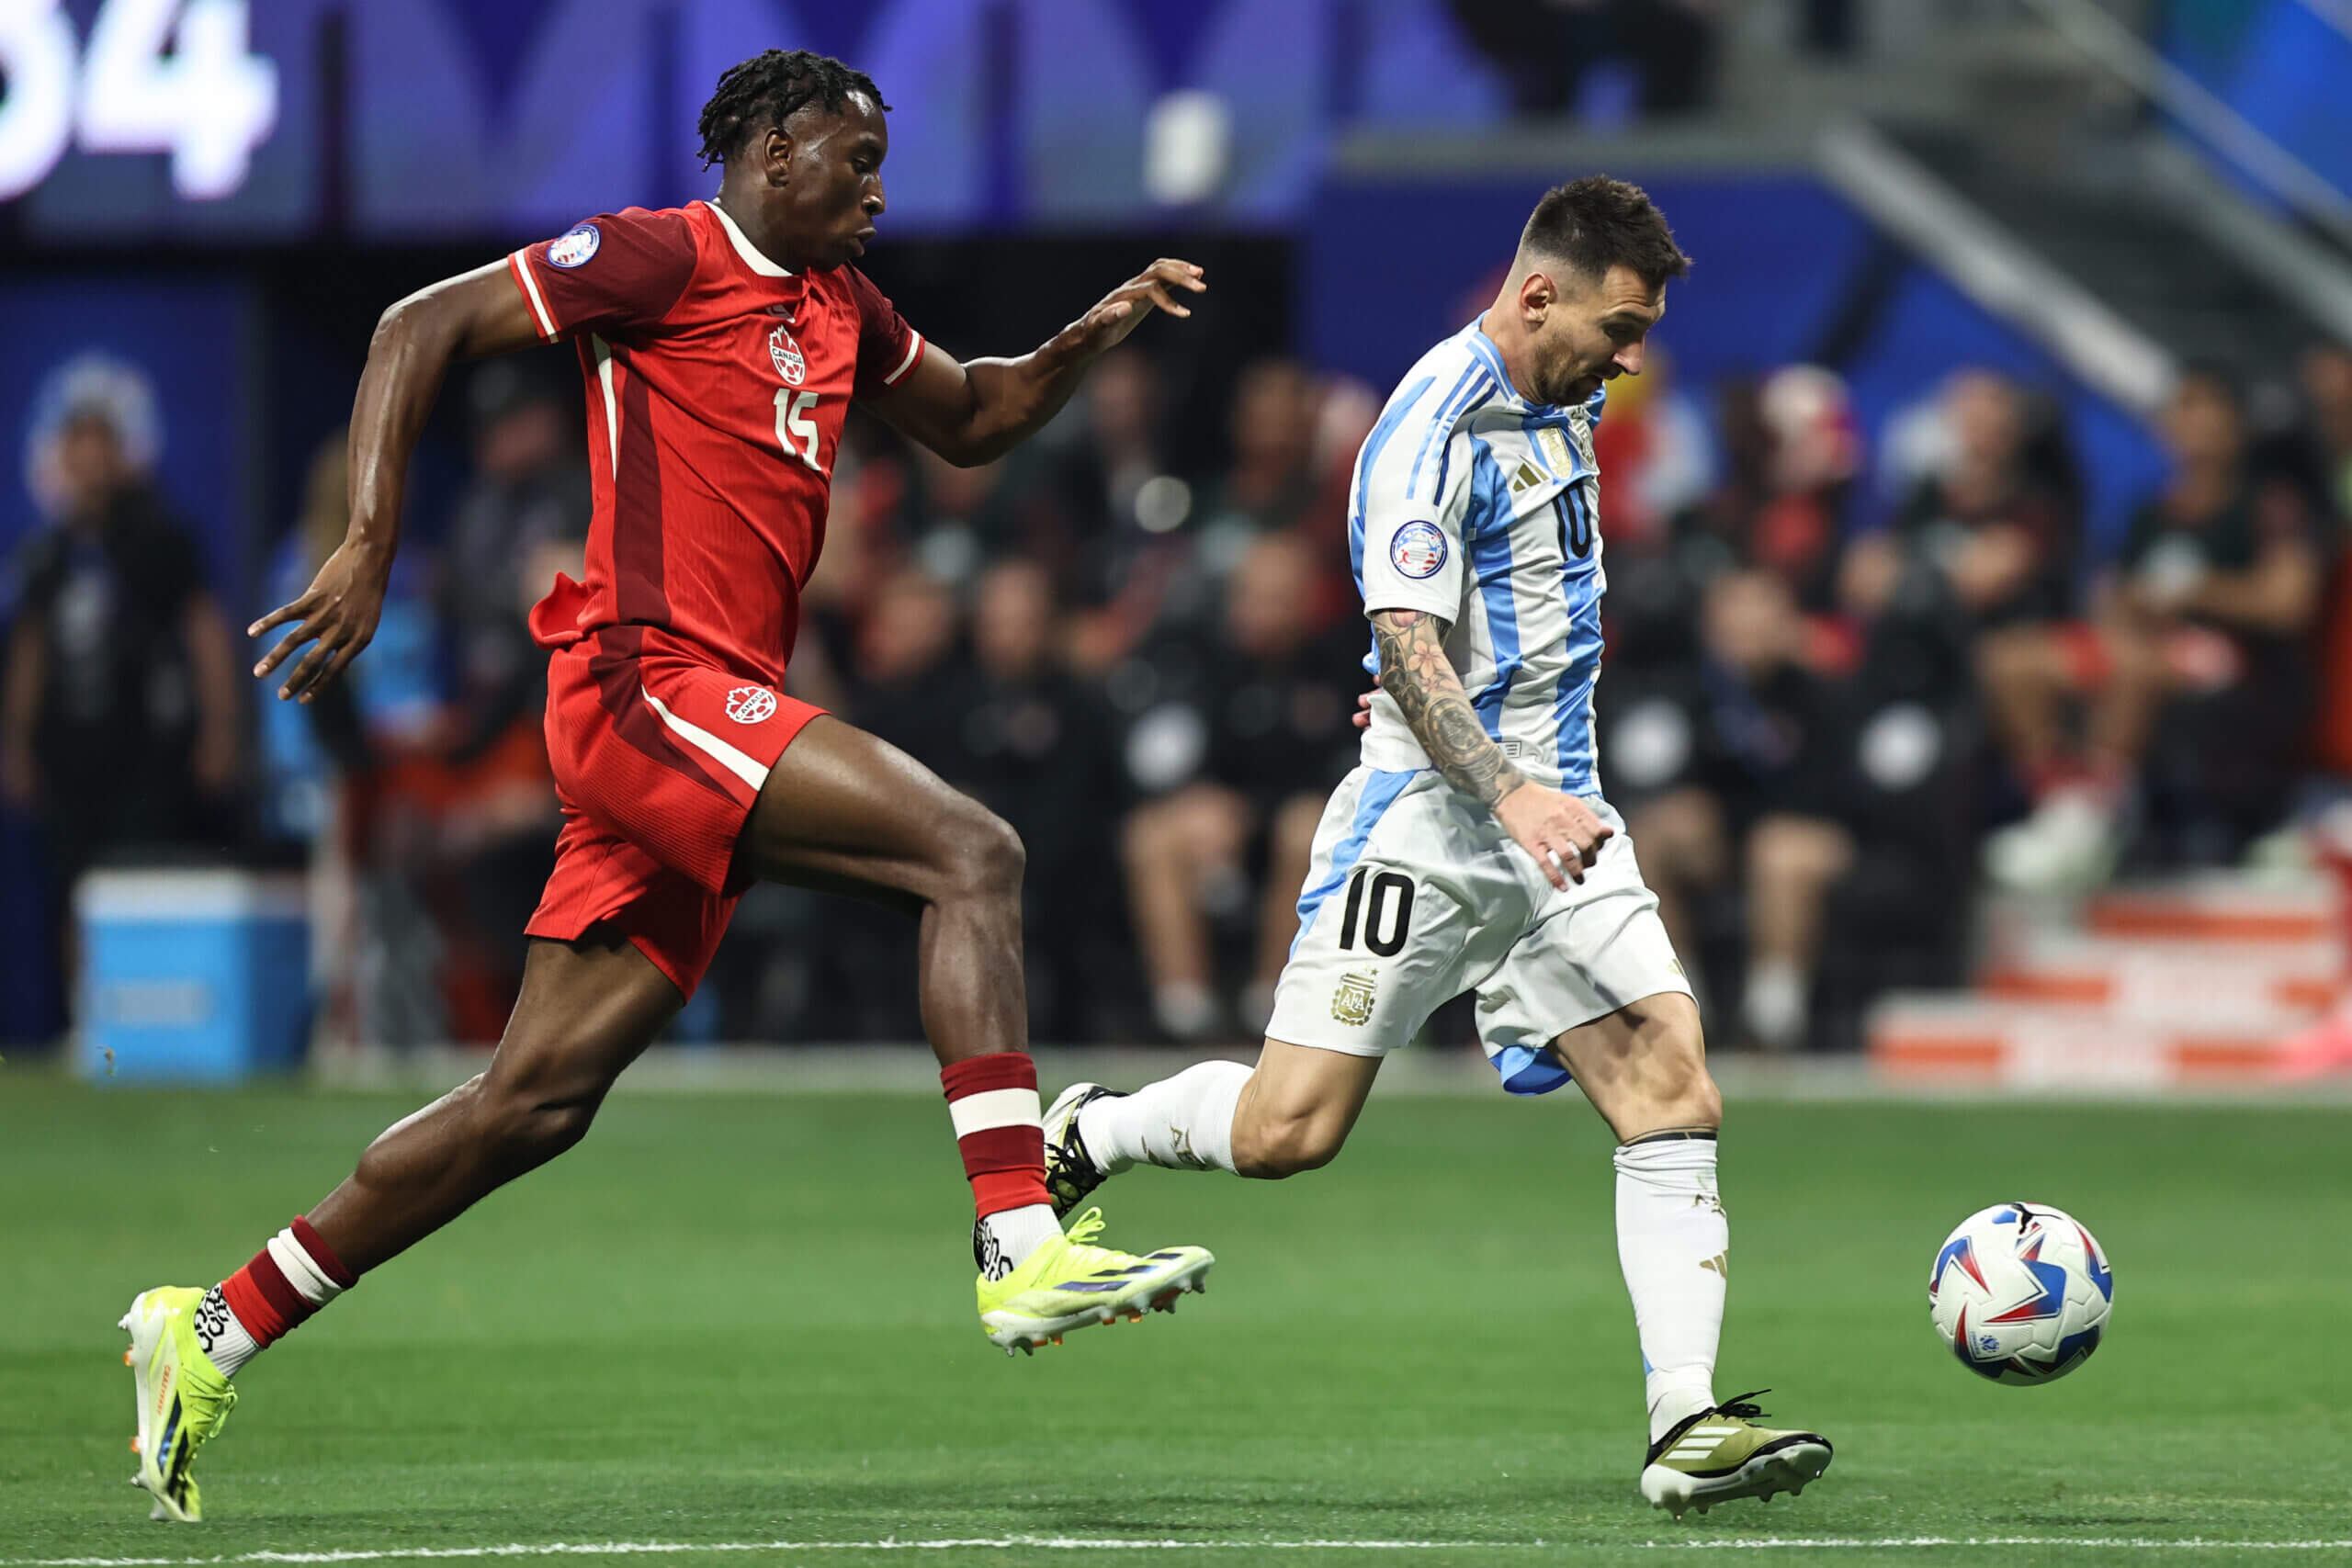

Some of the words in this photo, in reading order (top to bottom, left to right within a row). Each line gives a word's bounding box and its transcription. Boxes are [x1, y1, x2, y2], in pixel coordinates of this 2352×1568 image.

[772, 348, 803, 365] CANADA
[774, 388, 821, 471] 15
[1552, 477, 1592, 561] 10
[735, 691, 767, 720] CANADA
[1339, 867, 1415, 957] 10
